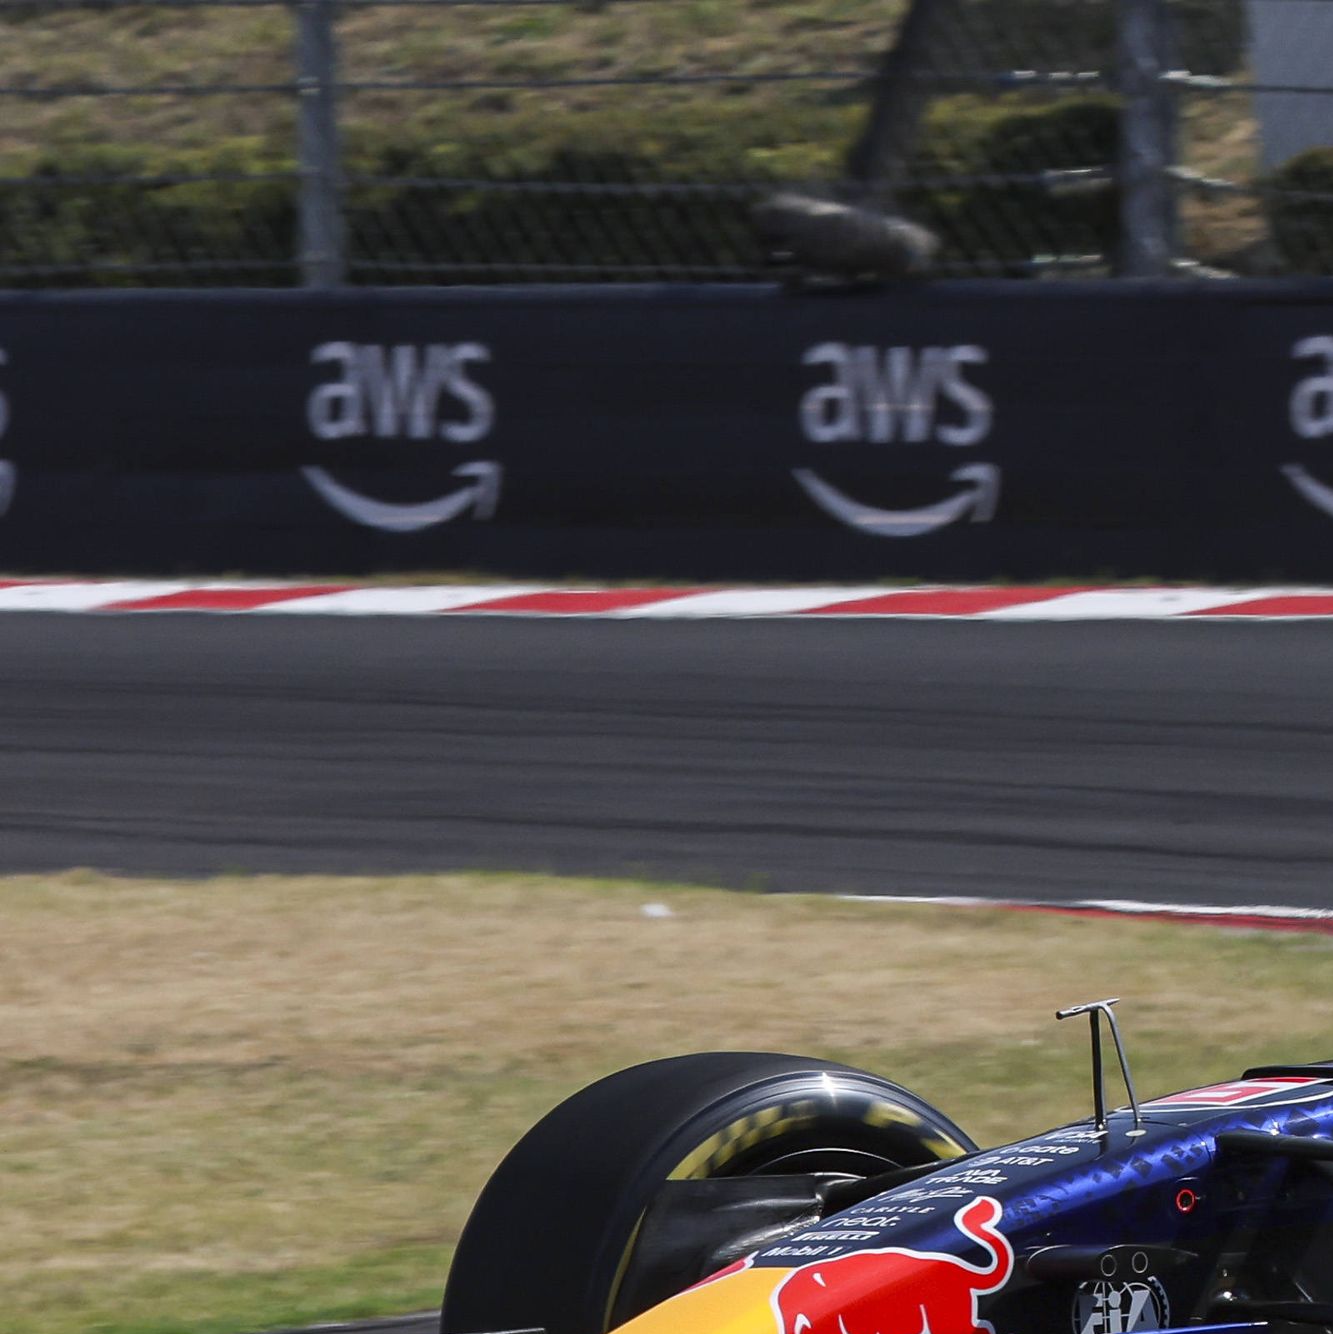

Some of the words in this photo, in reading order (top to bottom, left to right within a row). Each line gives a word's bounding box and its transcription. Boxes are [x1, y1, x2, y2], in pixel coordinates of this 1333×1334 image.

[306, 342, 494, 439] aws
[799, 342, 994, 446] aws
[993, 1156, 1055, 1166] AT&T
[925, 1175, 1008, 1185] TRADE
[850, 1206, 935, 1214] CARLYLE
[822, 1215, 902, 1228] neat.
[790, 1230, 880, 1242] PIRELLI
[762, 1245, 829, 1257] Mobil
